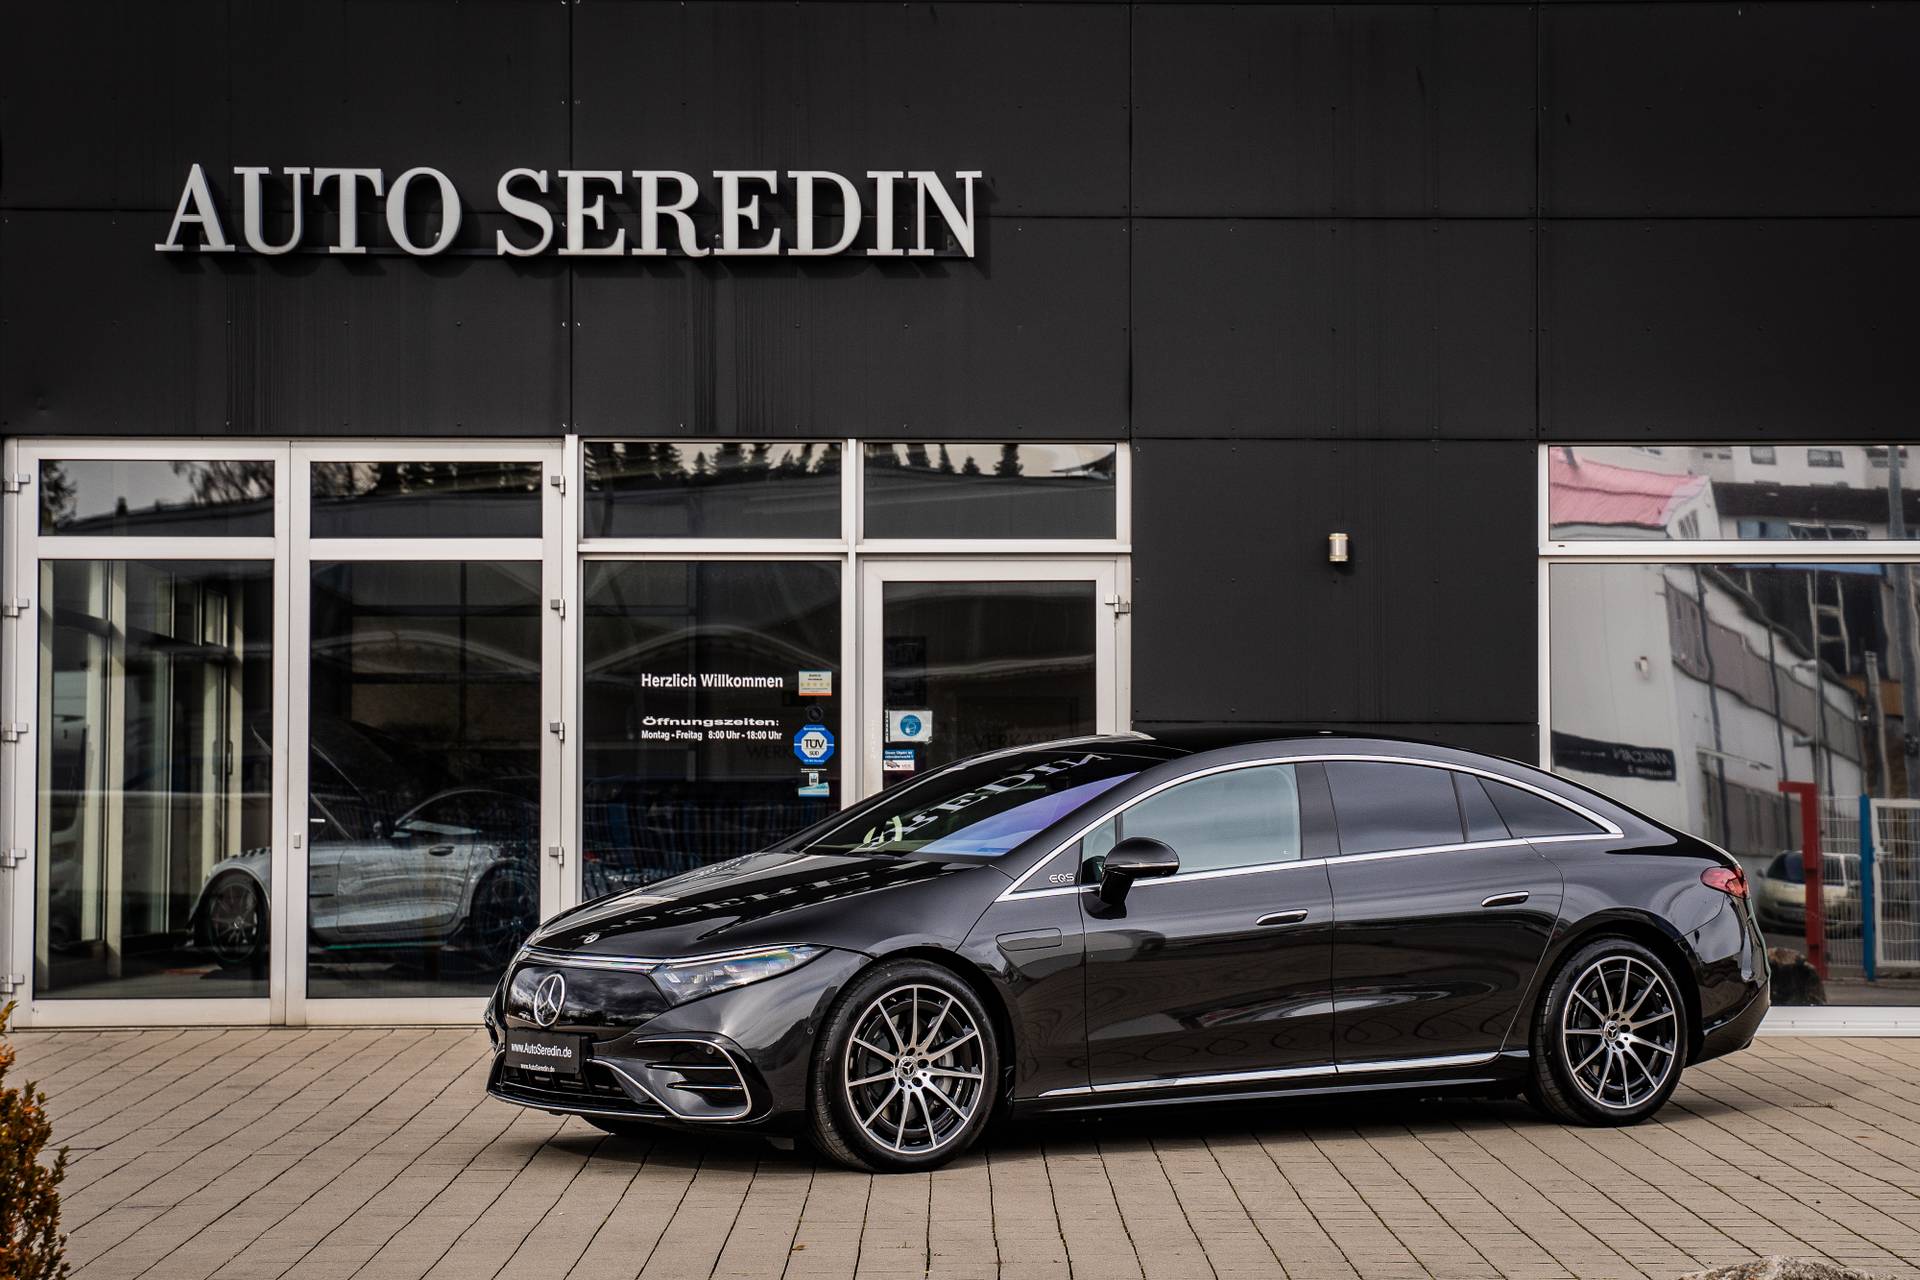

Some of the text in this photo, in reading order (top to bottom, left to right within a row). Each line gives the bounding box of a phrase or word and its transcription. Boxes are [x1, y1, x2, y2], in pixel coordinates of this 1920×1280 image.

[155, 164, 983, 258] AUTO SEREDIN
[641, 673, 784, 689] Herzlich Willkommen
[642, 716, 780, 728] Öffnungszeiten:
[641, 730, 671, 741] Montag
[676, 730, 703, 741] Freitag
[708, 730, 725, 740] 8:00
[726, 730, 741, 740] Uhr
[747, 730, 767, 740] 18:00
[768, 730, 783, 740] Uhr
[1048, 873, 1075, 883] EQS
[511, 1042, 573, 1059] www.AutoSeredin.de
